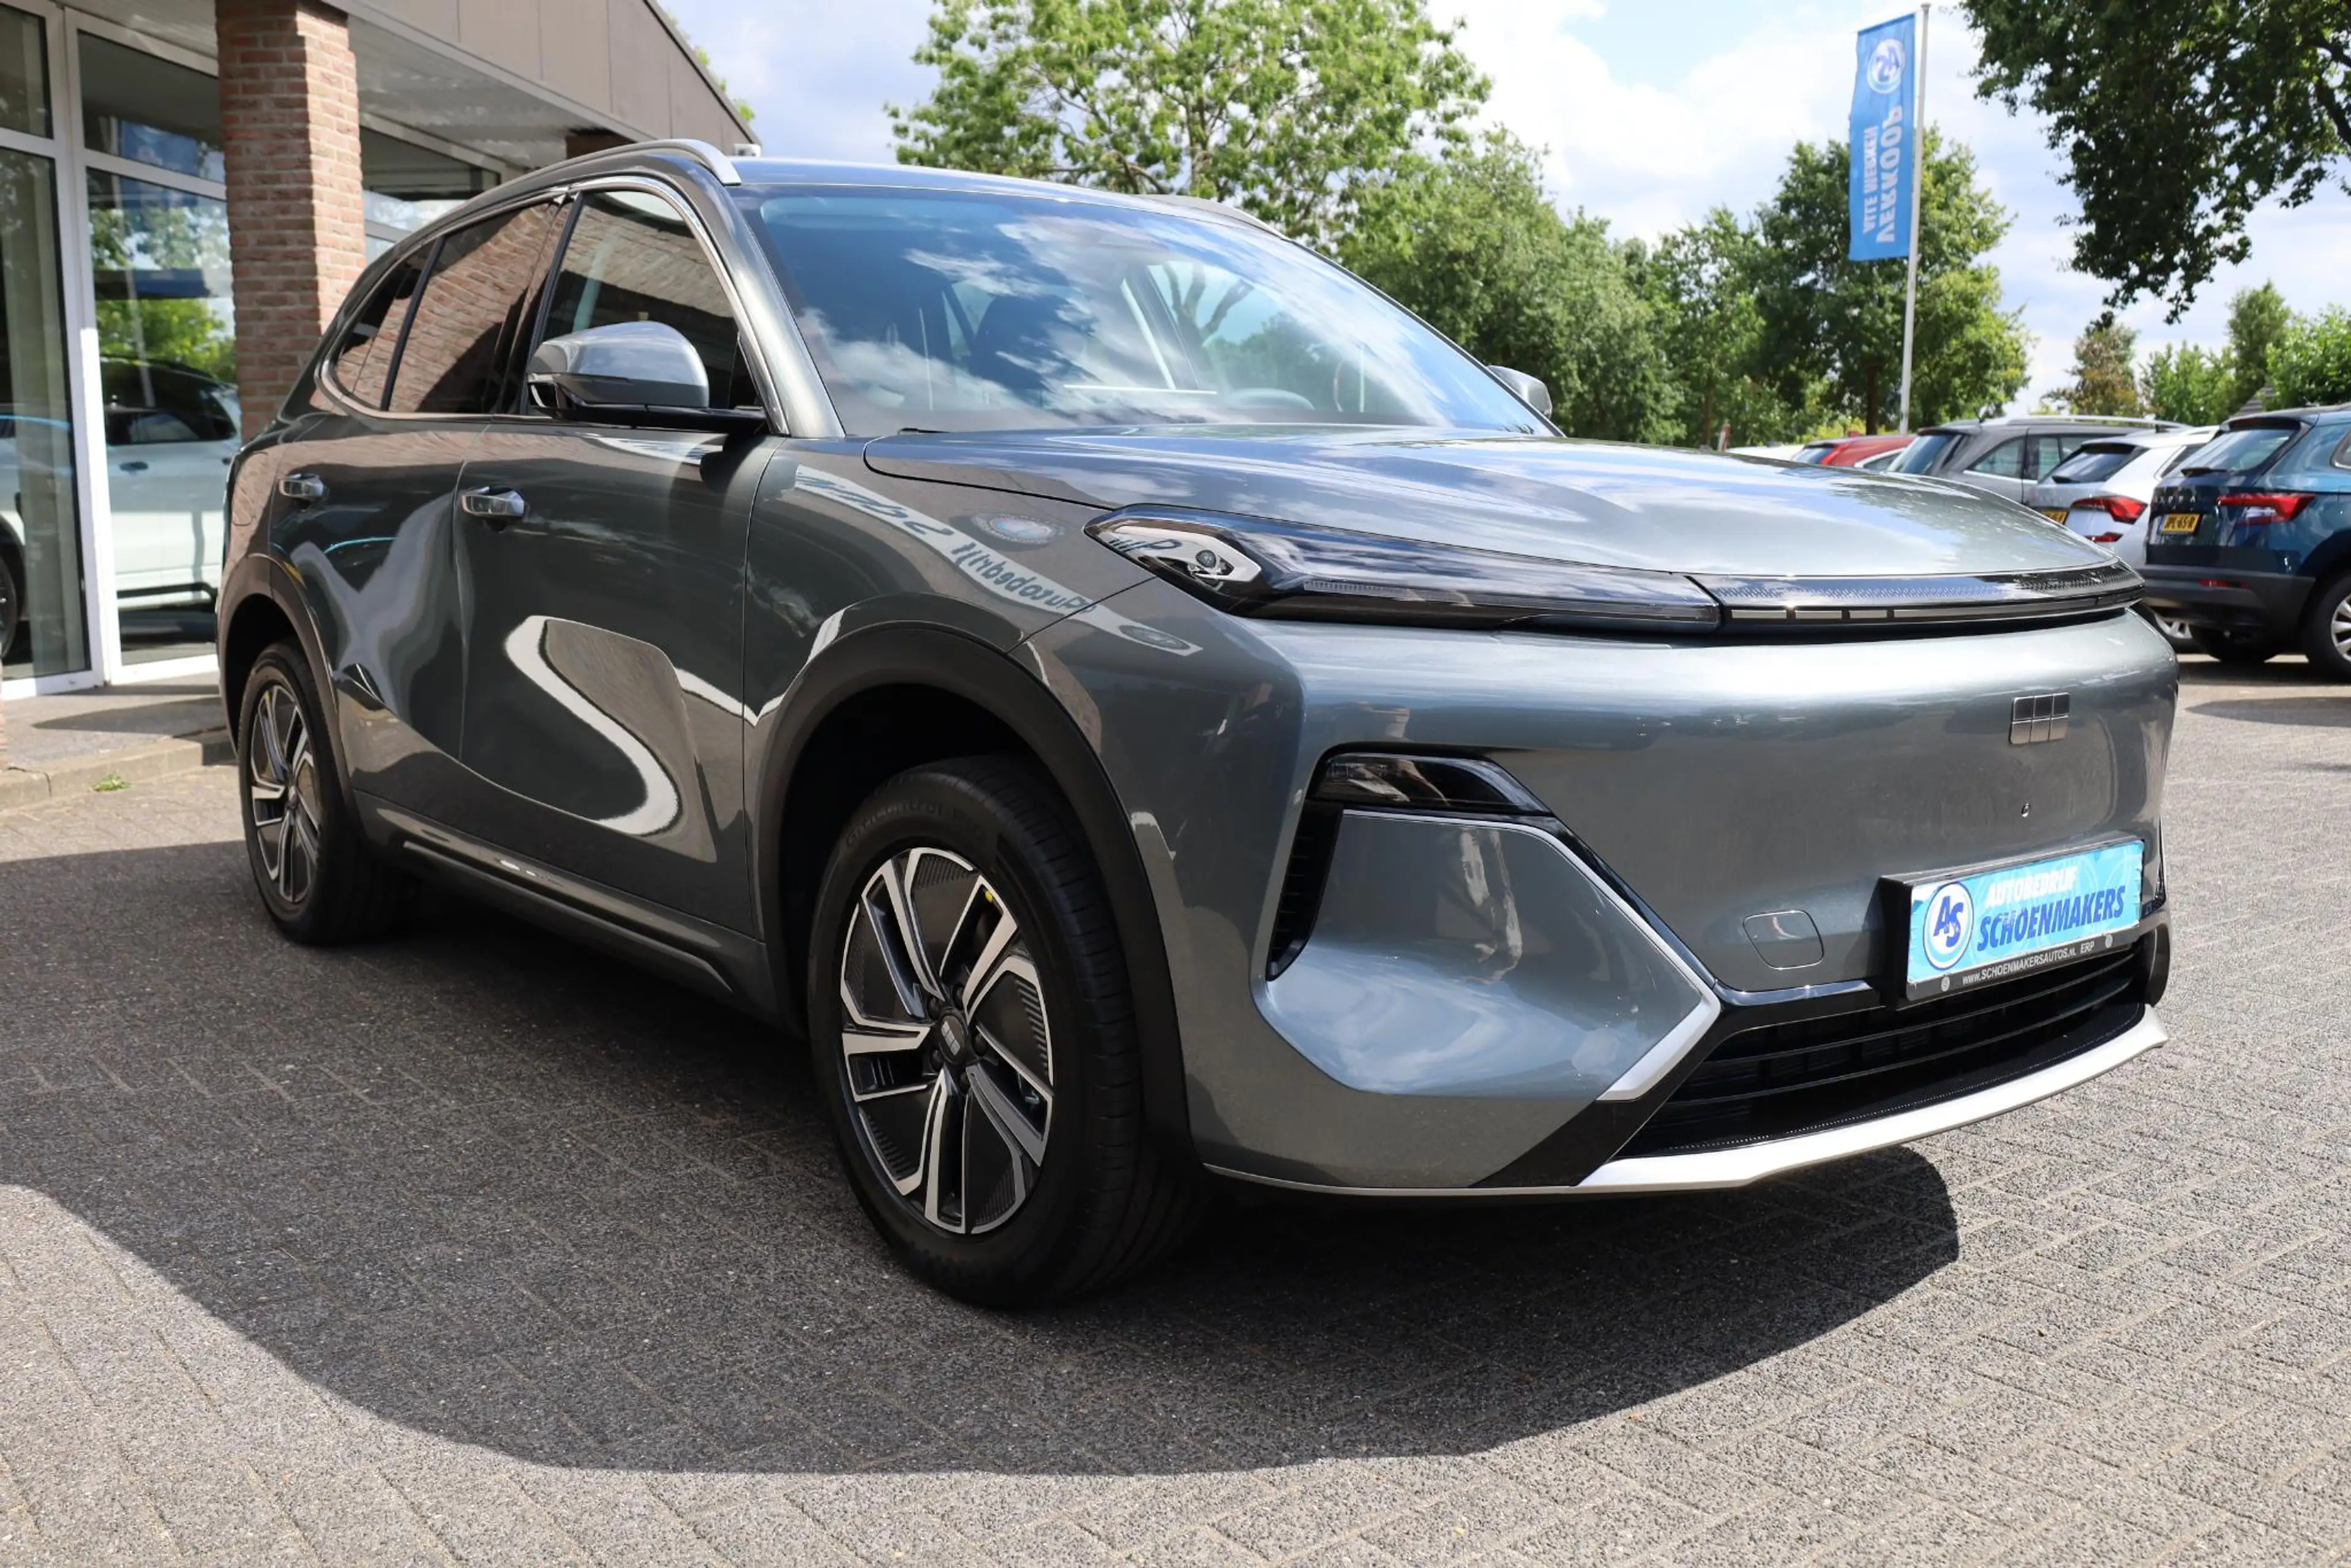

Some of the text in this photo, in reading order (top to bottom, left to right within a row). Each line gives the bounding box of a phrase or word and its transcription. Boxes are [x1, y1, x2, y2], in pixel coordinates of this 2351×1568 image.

[1984, 866, 2079, 908] AUTOBEDRIJF
[1932, 895, 1964, 948] AS
[1976, 885, 2126, 952] SCHOENMAKERS
[2080, 940, 2096, 955] ERP
